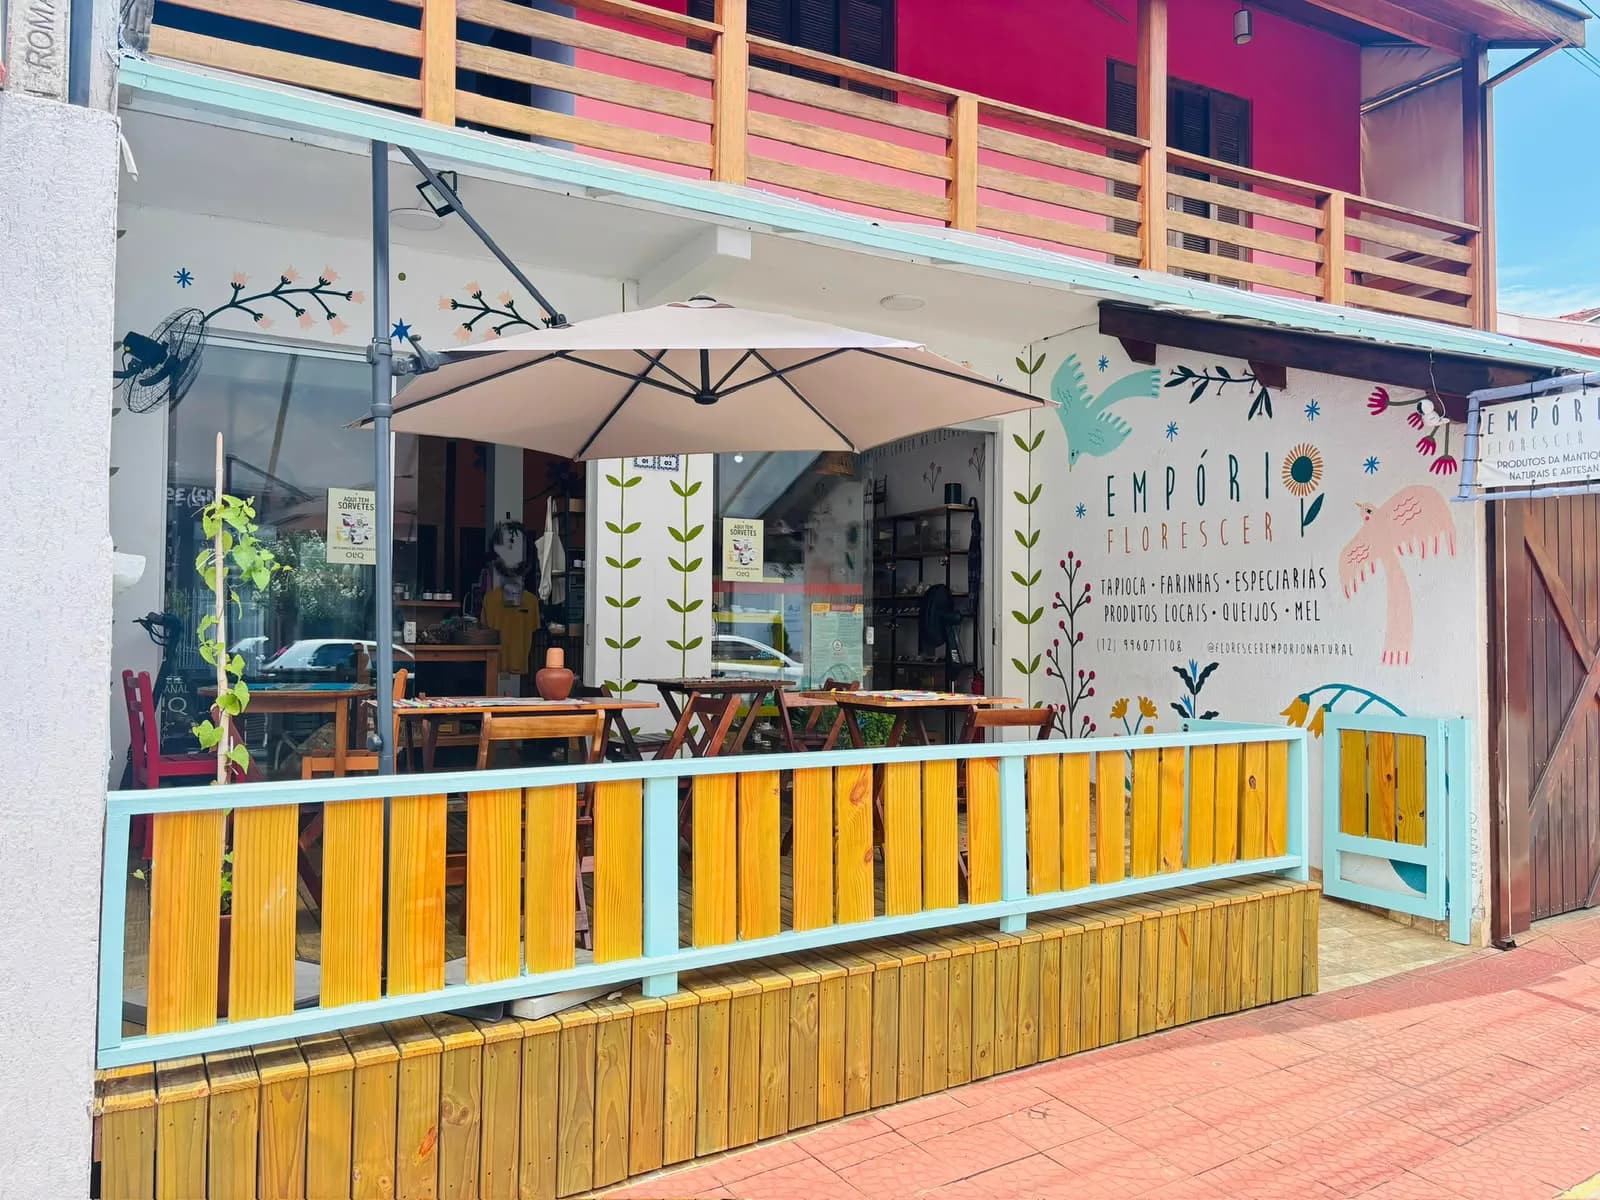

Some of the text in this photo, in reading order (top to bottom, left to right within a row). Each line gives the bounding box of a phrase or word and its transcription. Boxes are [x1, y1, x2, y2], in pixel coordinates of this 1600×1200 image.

[1496, 454, 1546, 470] PRODUTOS
[1548, 454, 1561, 465] DA
[1508, 468, 1551, 481] NATURAIS
[1552, 467, 1559, 477] E
[337, 501, 375, 511] SORVETES
[1107, 511, 1273, 555] FLORESCER
[1100, 567, 1328, 597] TAPIOCA FARINHAS ESPECIARIAS
[1104, 599, 1321, 624] PRODUTOS LOCAIS QUEIJOS MEL
[1096, 638, 1117, 653] (12)
[1122, 638, 1182, 653] 996071108
